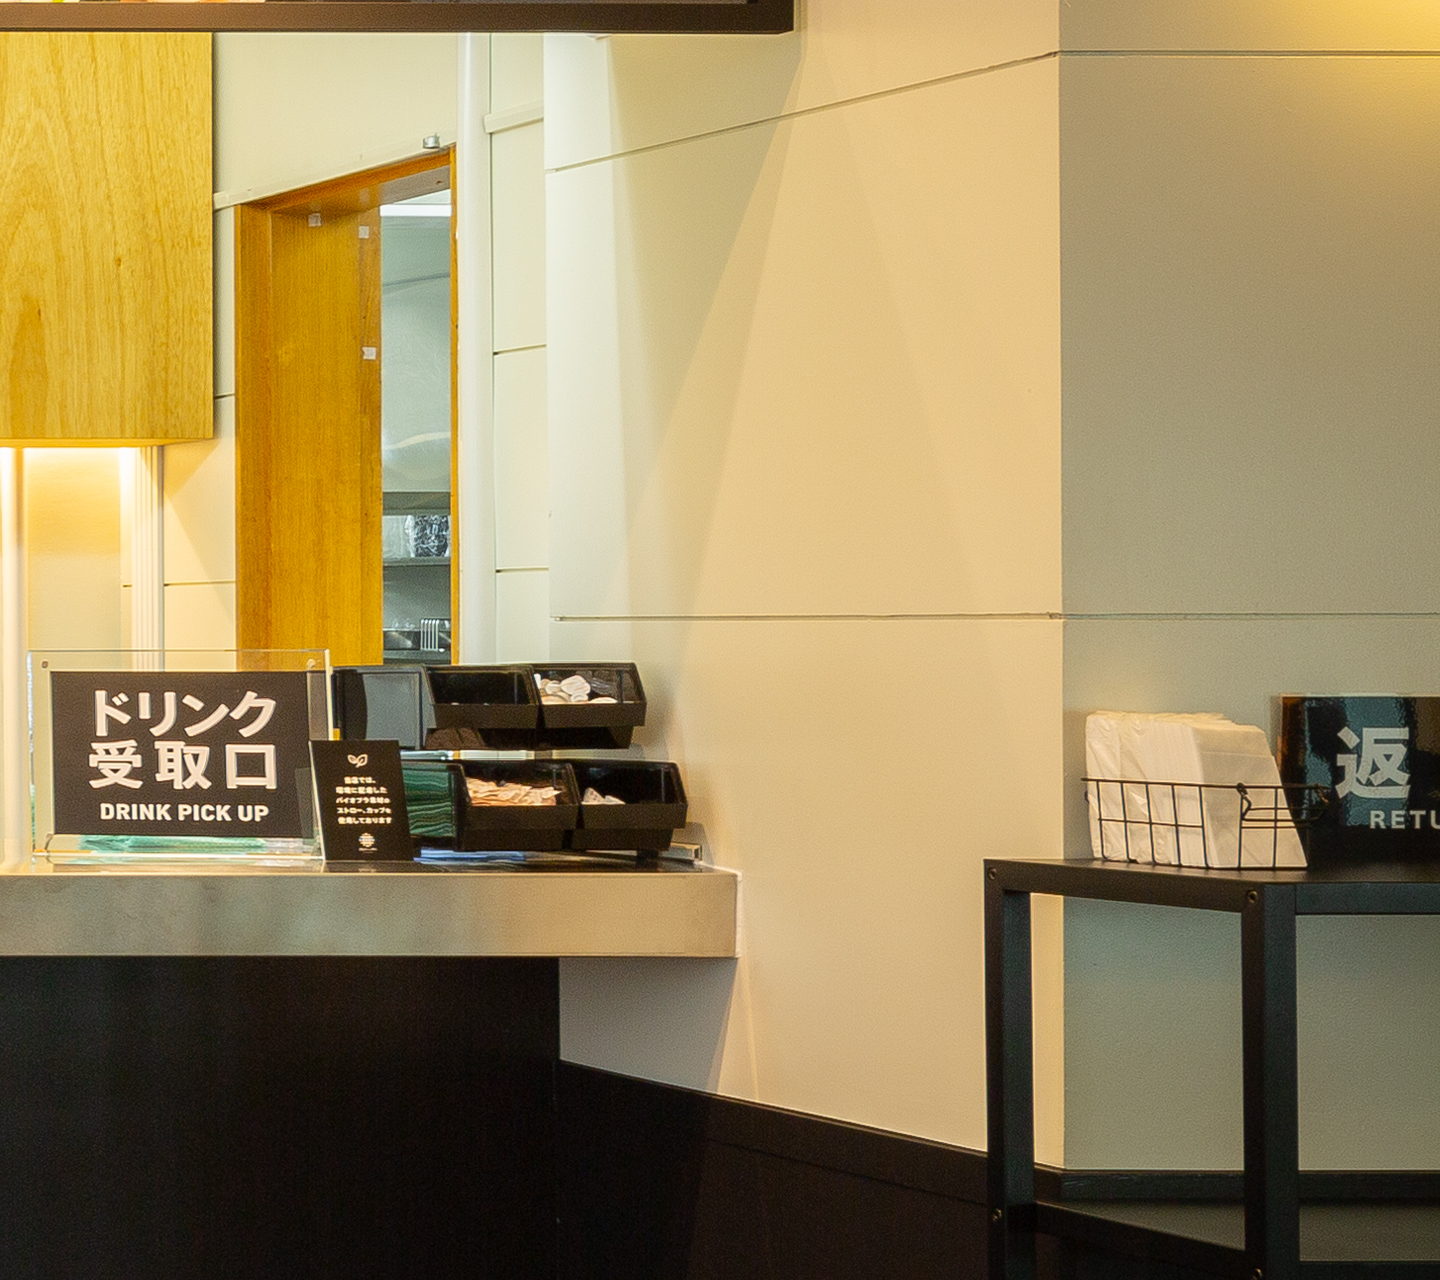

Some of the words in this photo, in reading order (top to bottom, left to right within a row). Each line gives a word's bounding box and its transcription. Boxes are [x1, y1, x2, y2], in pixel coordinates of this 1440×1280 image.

[95, 690, 277, 737] ドリンク
[88, 740, 277, 790] 受取口
[1336, 726, 1411, 799] 返
[100, 803, 173, 821] DRINK
[177, 804, 232, 821] PICK
[238, 804, 269, 823] UP
